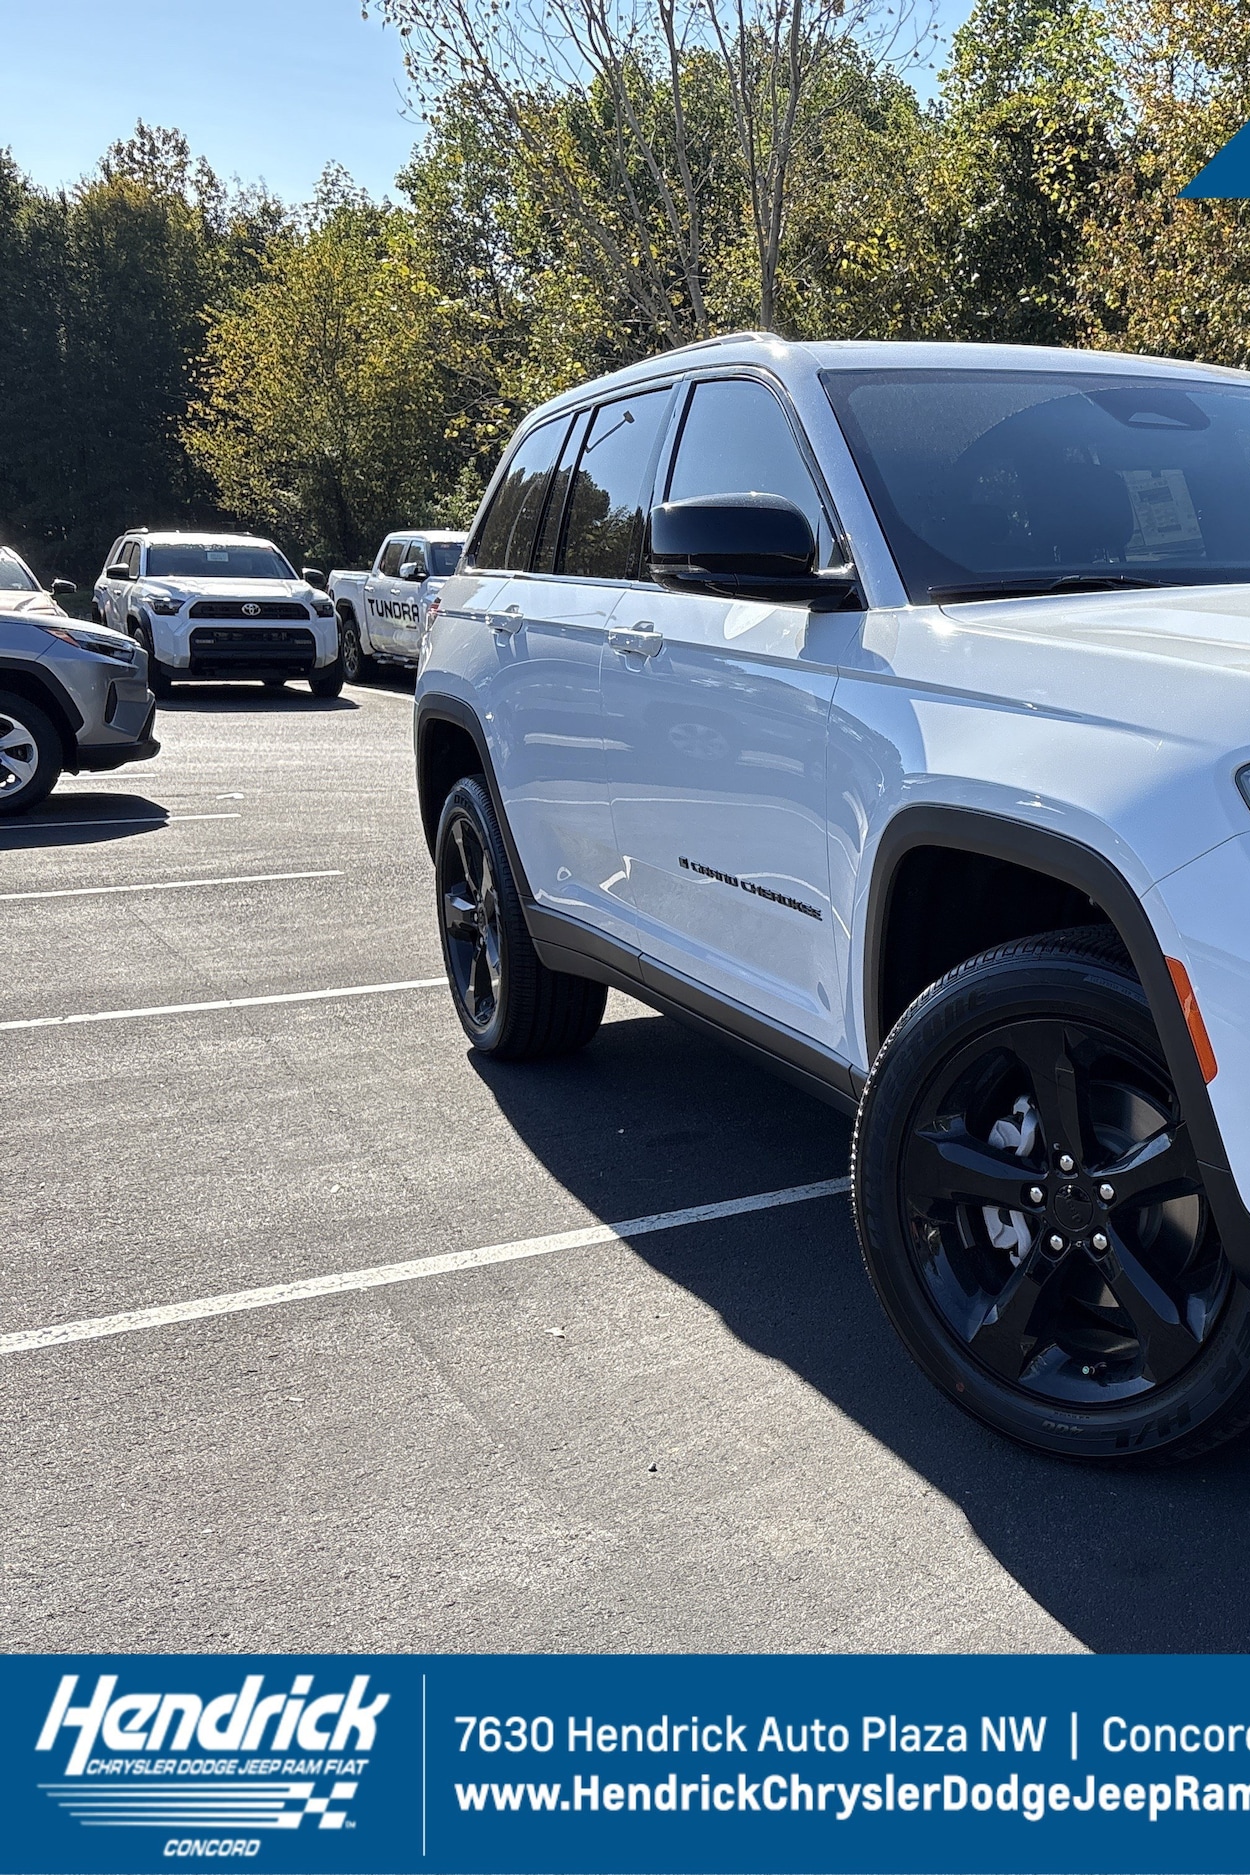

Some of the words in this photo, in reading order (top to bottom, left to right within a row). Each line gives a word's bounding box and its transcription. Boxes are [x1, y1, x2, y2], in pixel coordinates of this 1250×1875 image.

[367, 598, 420, 623] TUNDRA
[690, 861, 739, 888] GRAND
[740, 879, 824, 922] CHEROKEE
